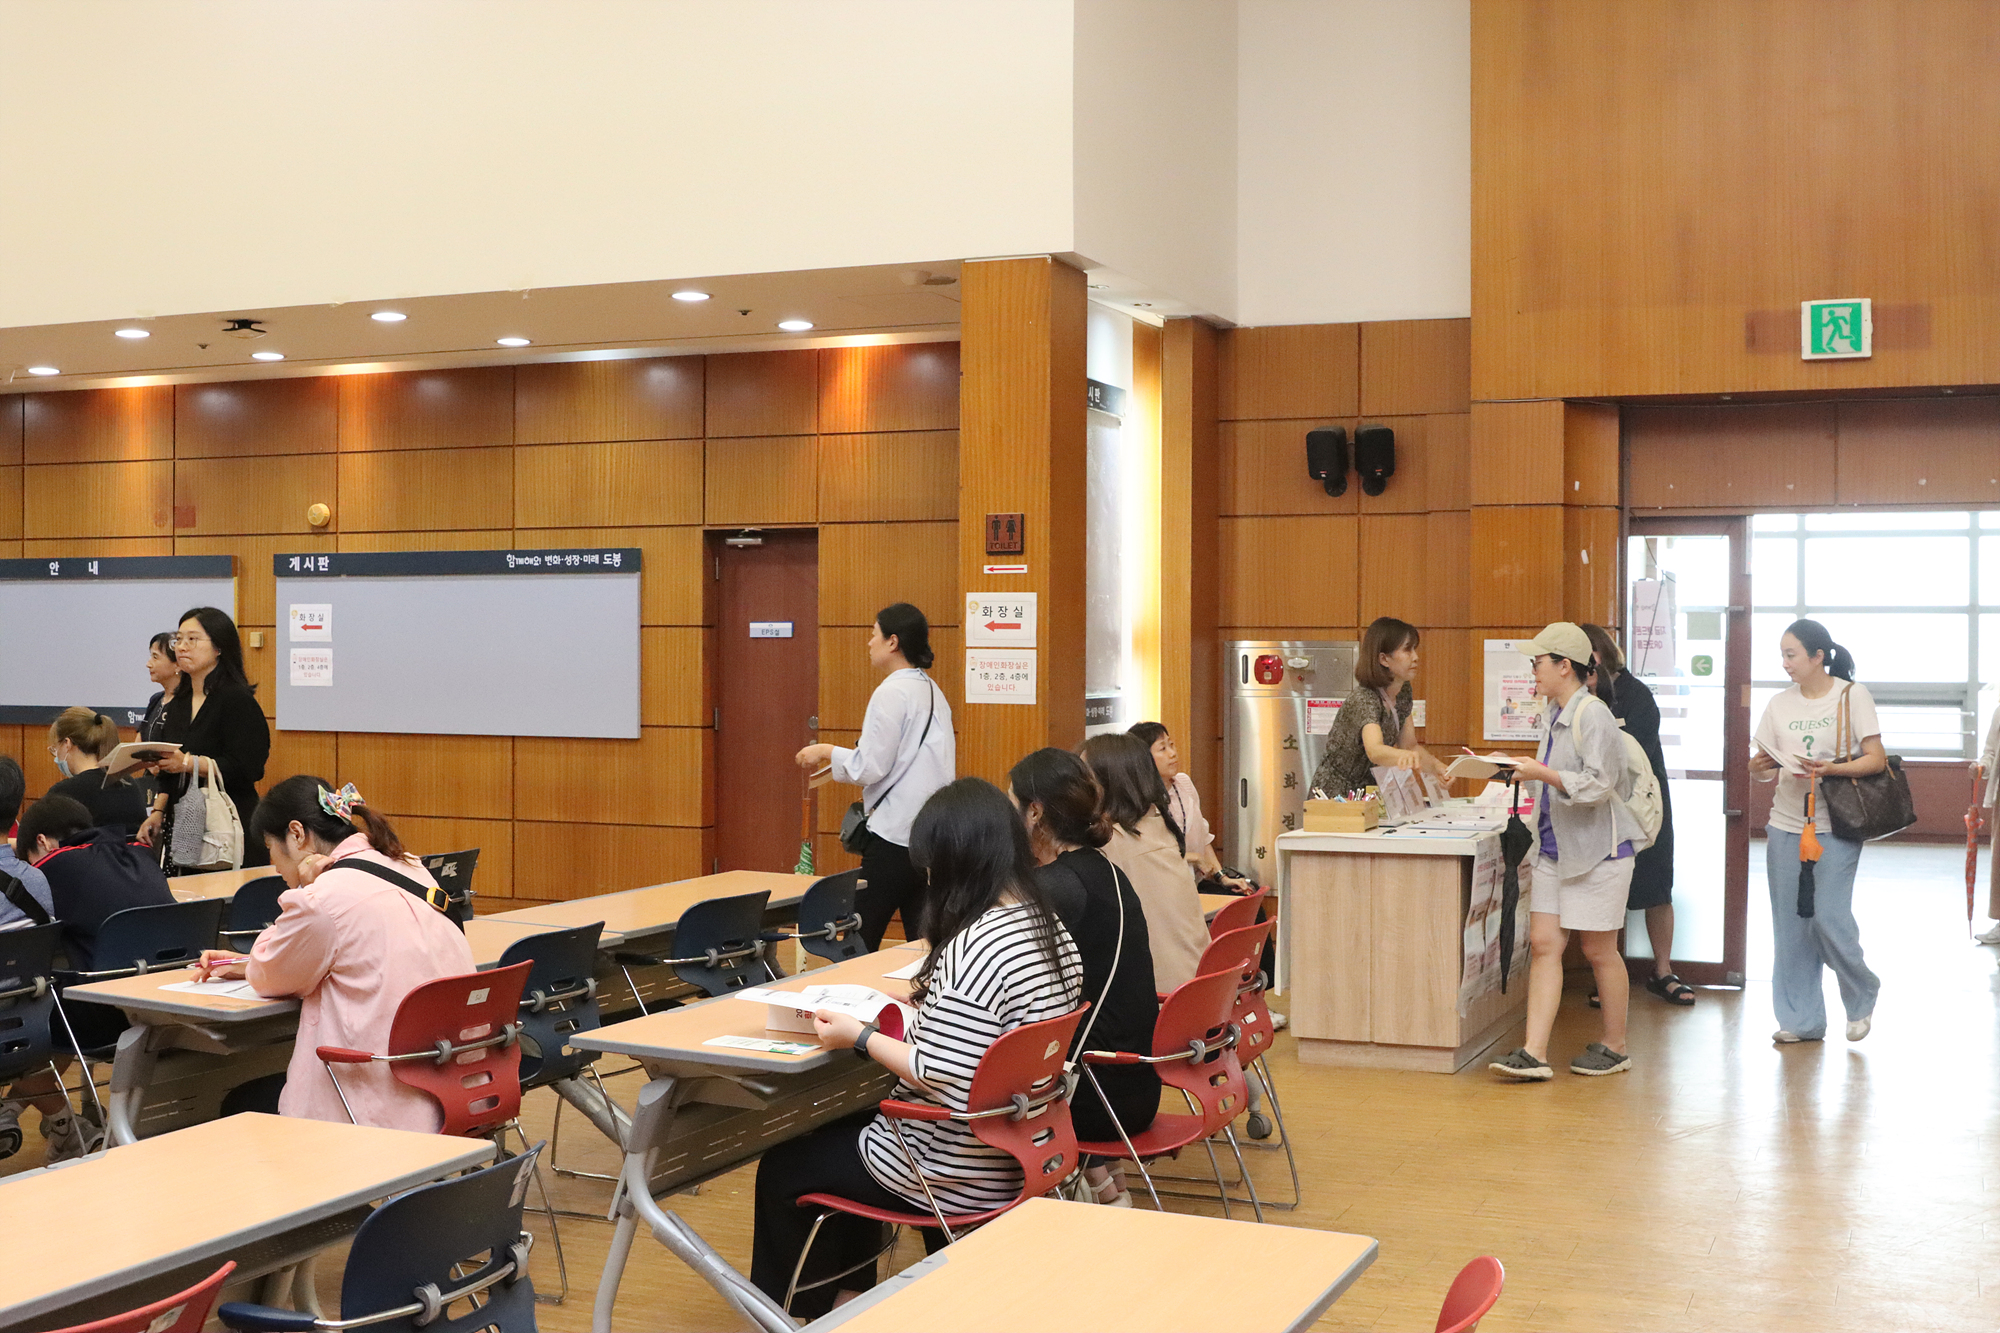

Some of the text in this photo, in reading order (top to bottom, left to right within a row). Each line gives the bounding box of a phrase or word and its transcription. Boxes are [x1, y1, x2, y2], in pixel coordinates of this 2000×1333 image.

[1088, 386, 1100, 402] 시판
[989, 541, 1018, 550] TOILET
[289, 556, 330, 571] 게시판
[602, 553, 621, 567] 도봉
[979, 661, 1029, 670] 장애인화장실은
[979, 672, 1029, 681] 1층, 2층, 4층에
[987, 683, 1018, 692] 있습니다.
[127, 711, 146, 724] 함께
[1788, 717, 1830, 731] GUESS
[1255, 846, 1267, 859] 방
